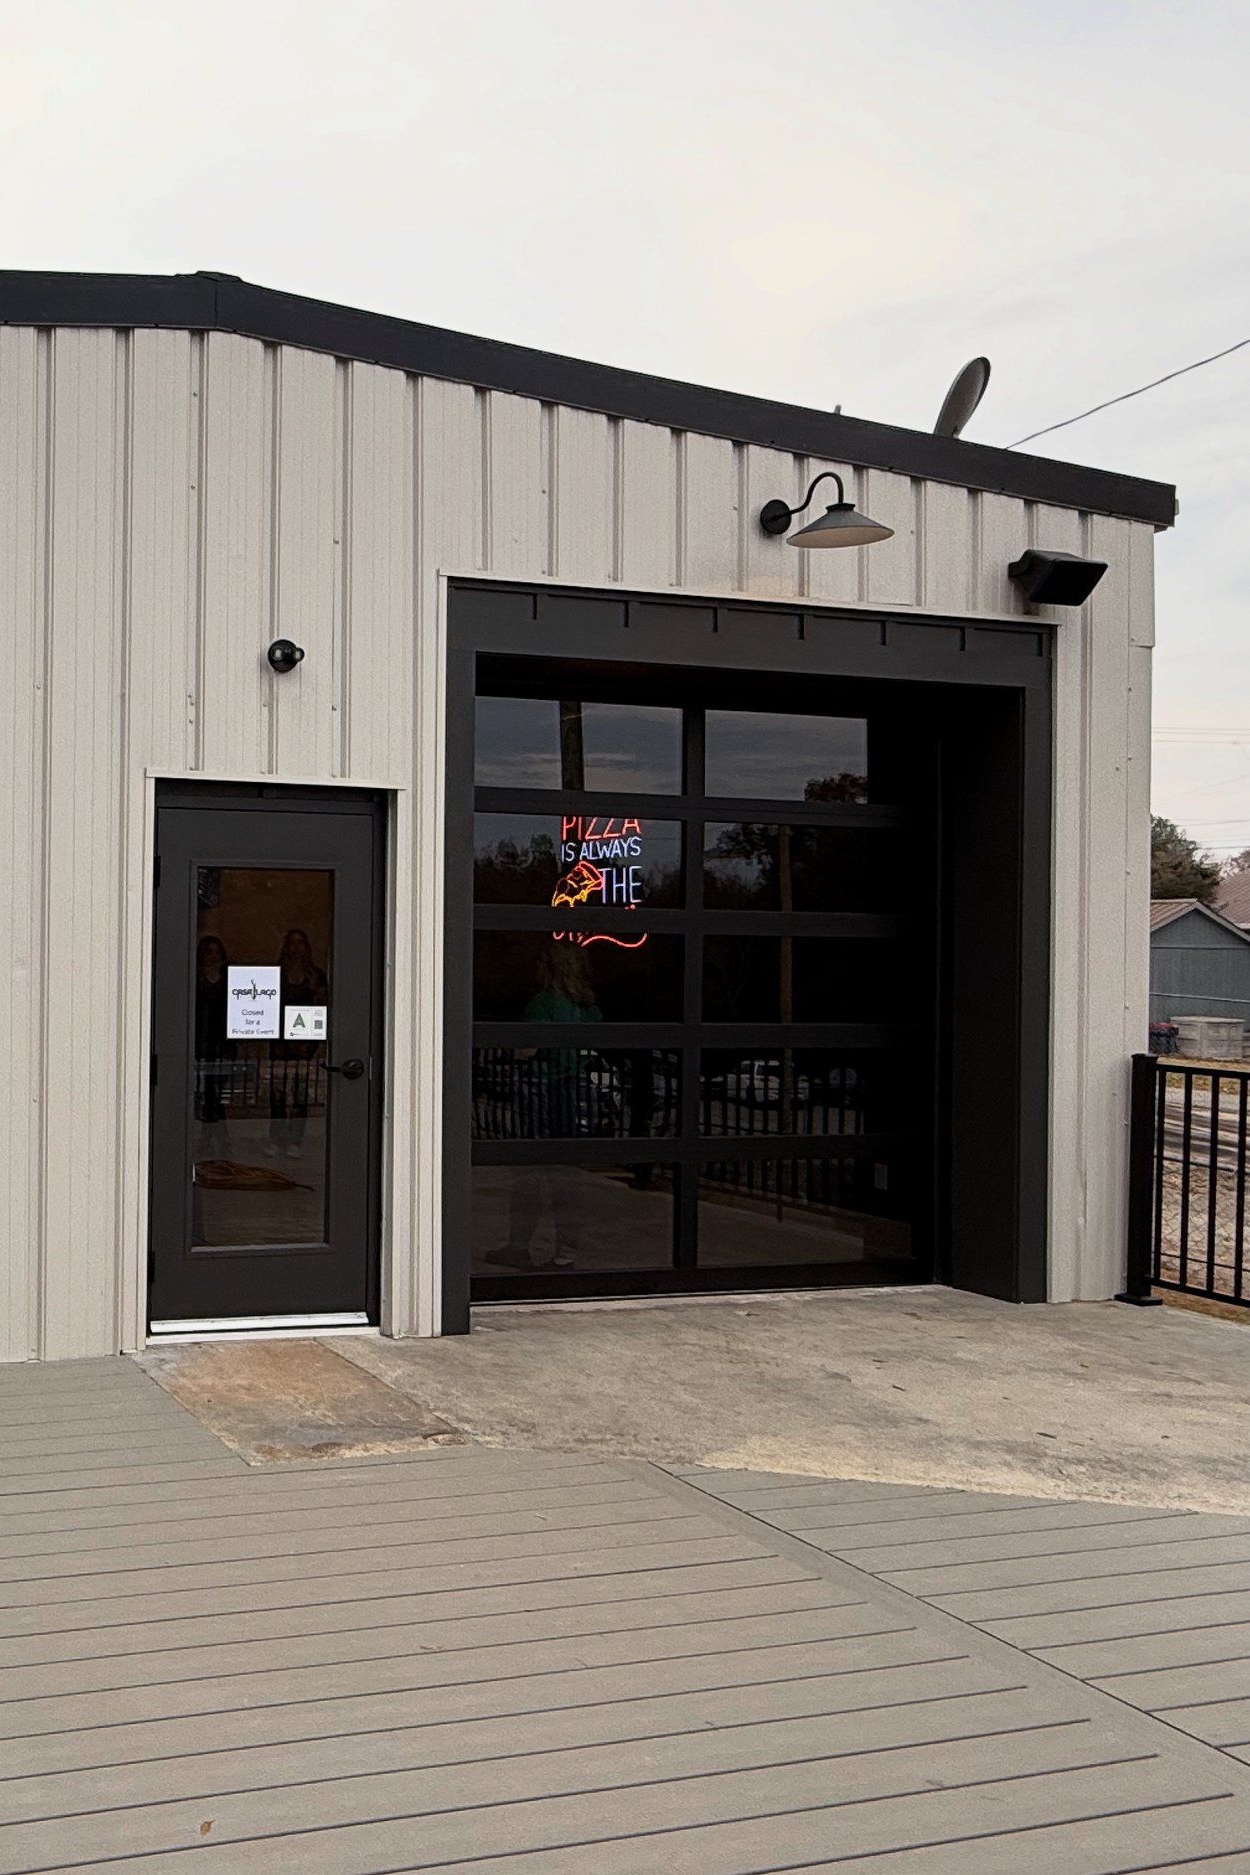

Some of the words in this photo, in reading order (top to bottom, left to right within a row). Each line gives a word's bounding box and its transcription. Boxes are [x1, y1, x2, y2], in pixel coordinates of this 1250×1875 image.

[562, 816, 642, 841] PIZZA
[561, 842, 576, 863] IS
[579, 836, 643, 861] ALWAYS
[598, 865, 643, 904] THE
[292, 1012, 306, 1028] A
